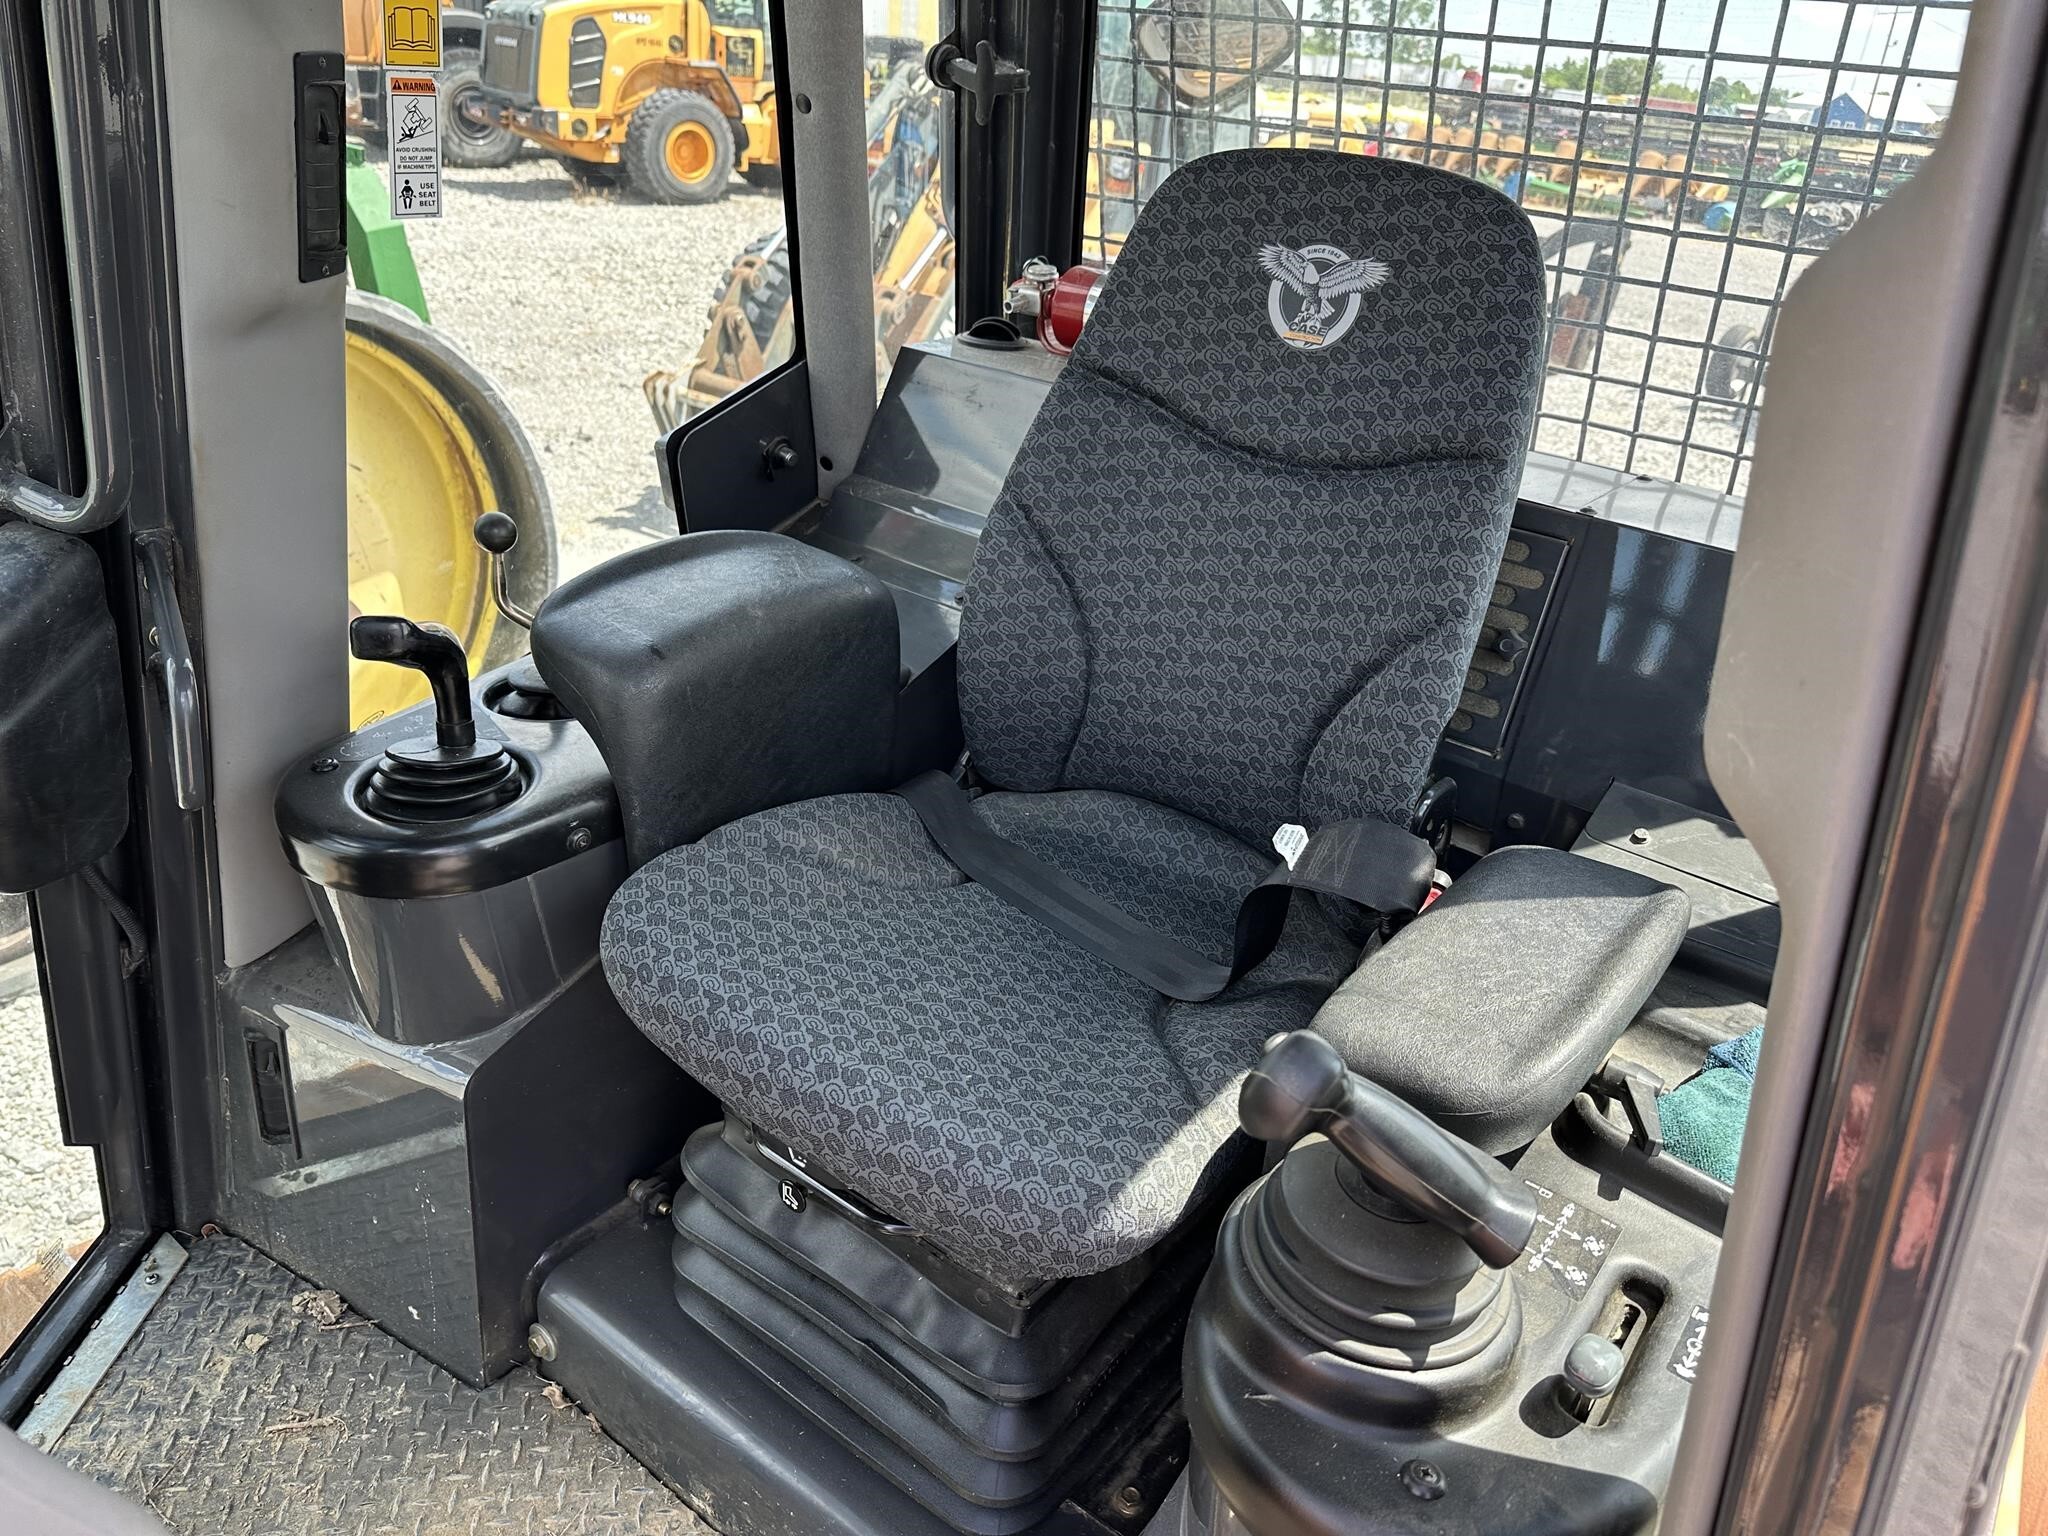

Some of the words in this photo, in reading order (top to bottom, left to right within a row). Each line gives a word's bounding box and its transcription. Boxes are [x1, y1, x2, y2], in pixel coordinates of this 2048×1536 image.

[402, 82, 436, 92] WARNING
[1307, 247, 1326, 255] SINCE
[1288, 322, 1328, 336] CASE
